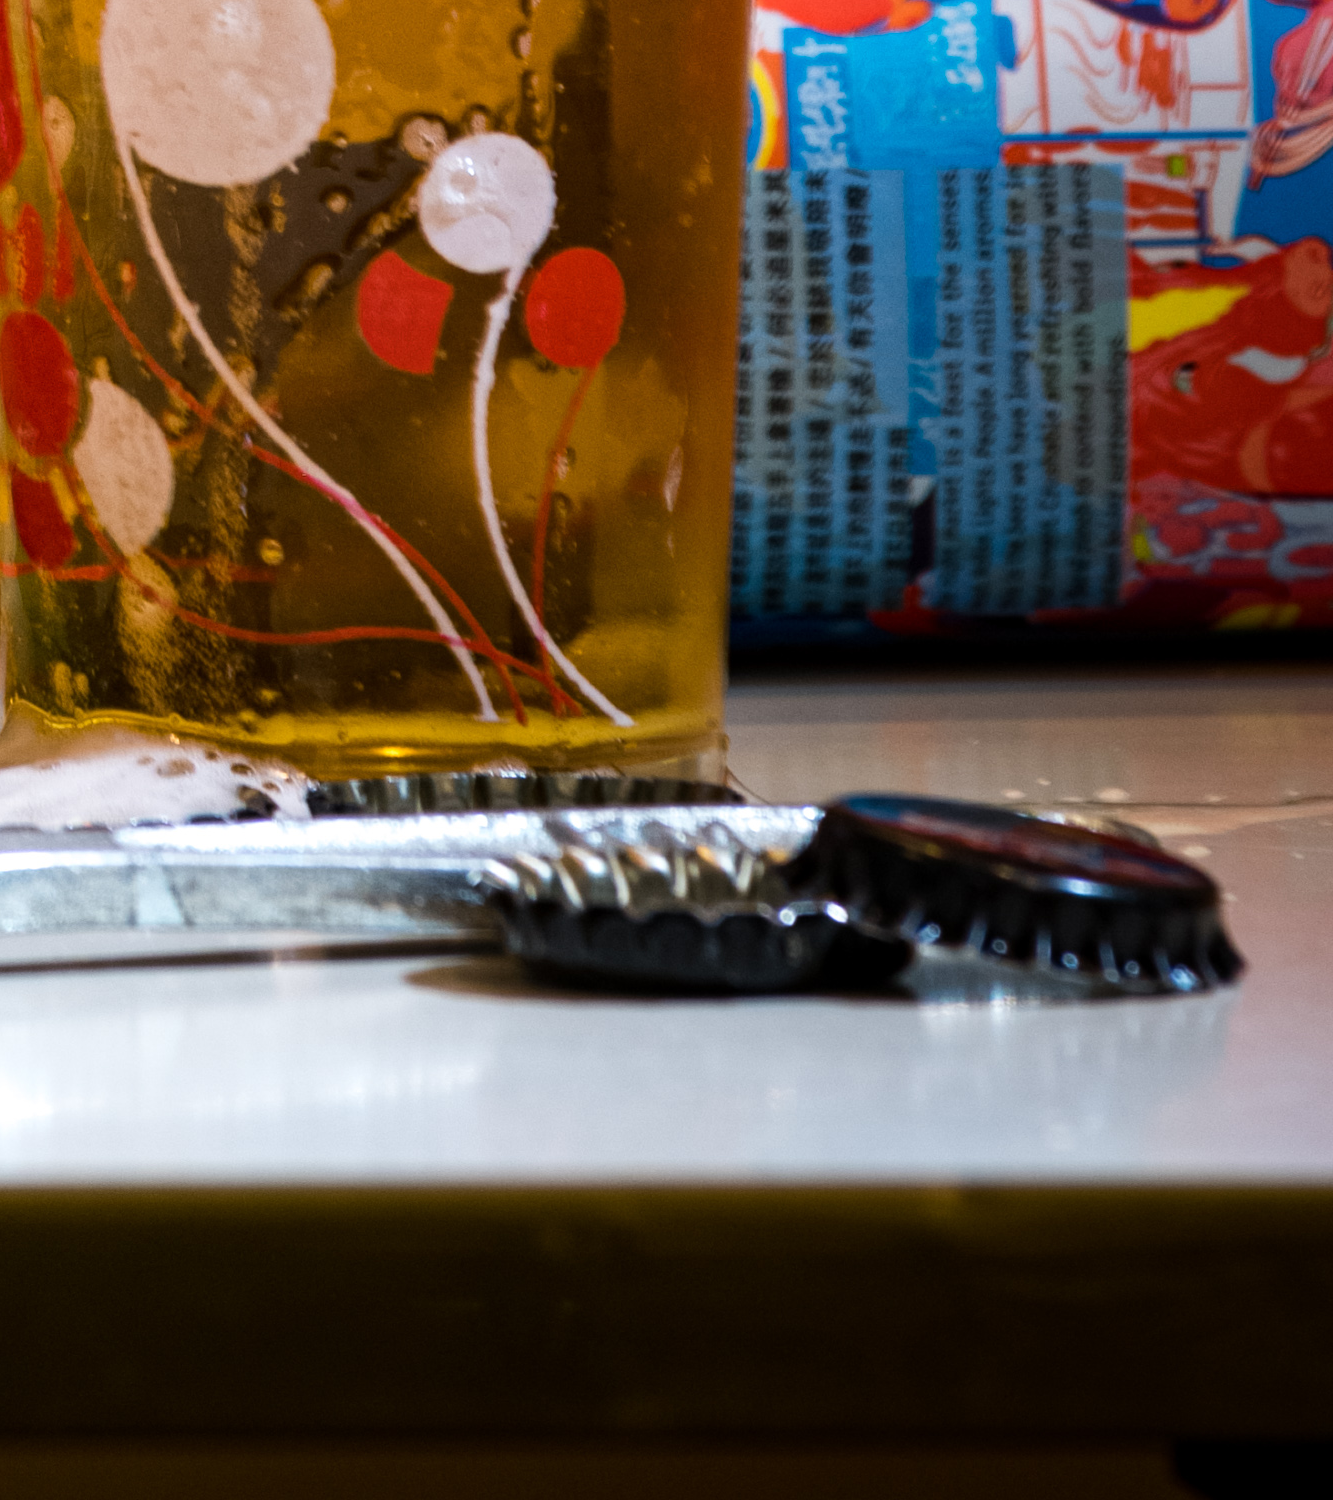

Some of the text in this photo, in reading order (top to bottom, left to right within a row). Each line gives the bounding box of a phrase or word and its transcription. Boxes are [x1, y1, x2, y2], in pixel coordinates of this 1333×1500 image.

[1000, 198, 1025, 236] for
[941, 262, 962, 301] the
[972, 267, 995, 356] million
[941, 313, 963, 349] for
